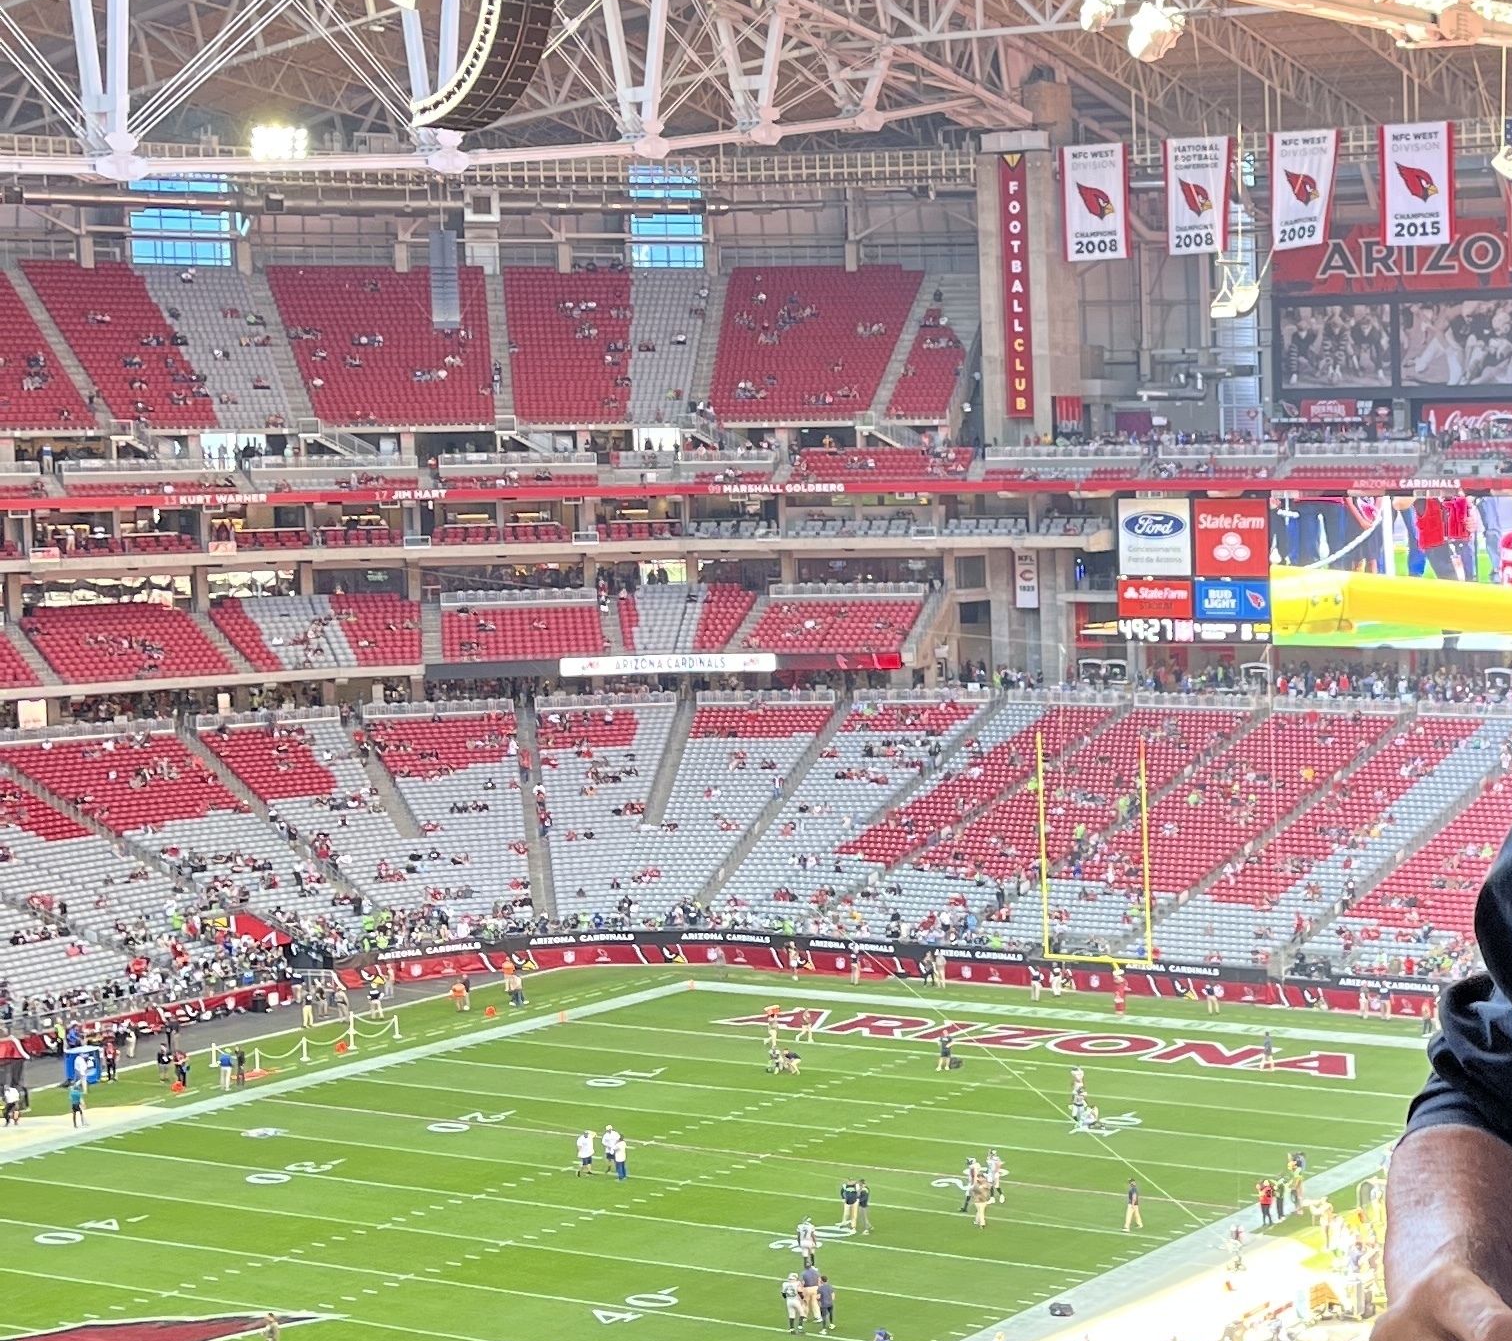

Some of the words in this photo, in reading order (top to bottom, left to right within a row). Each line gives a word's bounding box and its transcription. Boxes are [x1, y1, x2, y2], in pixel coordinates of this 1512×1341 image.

[1281, 138, 1299, 146] NFC
[1302, 136, 1327, 145] WEST
[1392, 133, 1411, 141] NFC
[1414, 131, 1439, 140] WEST
[1090, 150, 1114, 158] WEST
[1280, 147, 1327, 158] DIVISION
[1391, 142, 1440, 153] DIVISION
[1072, 160, 1116, 170] DIVISION
[1280, 216, 1317, 227] CHAMPIONS
[1394, 212, 1440, 220] CHAMPIONS
[1075, 230, 1117, 238] CHAMPIONS
[1279, 225, 1316, 243] 2009
[1394, 221, 1441, 237] 2015
[1075, 239, 1118, 254] 2008
[1175, 232, 1214, 248] 2008
[1008, 181, 1024, 333] FOOTBALL
[1013, 338, 1027, 411] CLUB
[723, 484, 783, 493] MARSHALL
[785, 483, 845, 493] GOLDBERG
[1353, 479, 1399, 489] ARIZONA
[1399, 478, 1460, 489] CARDINALS
[163, 496, 176, 505] 13
[179, 495, 211, 504] KURT
[216, 493, 267, 505] WARNER
[375, 491, 388, 501] 17
[391, 489, 412, 500] JIM
[414, 489, 447, 499] HART
[1134, 514, 1174, 535] Ford
[1198, 514, 1231, 530] State
[1232, 514, 1265, 529] Farm
[1138, 587, 1164, 600] State
[1163, 587, 1188, 600] Farm
[1208, 589, 1233, 599] BUD
[1204, 599, 1237, 609] LIGHT
[1118, 618, 1173, 642] 49:27
[615, 658, 663, 670] ARIZONA
[666, 656, 727, 669] CARDINALS
[529, 935, 577, 946] ARIZONA
[579, 933, 635, 944] CARDINALS
[681, 932, 724, 942] ARIZONA
[725, 933, 771, 944] CARDINALS
[377, 947, 423, 961] ARIZONA
[425, 942, 482, 956] CARDINALS
[809, 939, 845, 951] ARIZONA
[848, 941, 894, 954] CARDINALS
[934, 948, 972, 959] ARIZONA
[974, 950, 1023, 962] CARDINALS
[1126, 962, 1166, 973] ARIZONA
[1168, 965, 1220, 977] CARDINALS
[1338, 977, 1383, 989] ARIZONA
[1386, 980, 1440, 993] CARDINALS
[709, 1007, 1357, 1079] ARIZONA
[592, 1292, 678, 1326] 40
